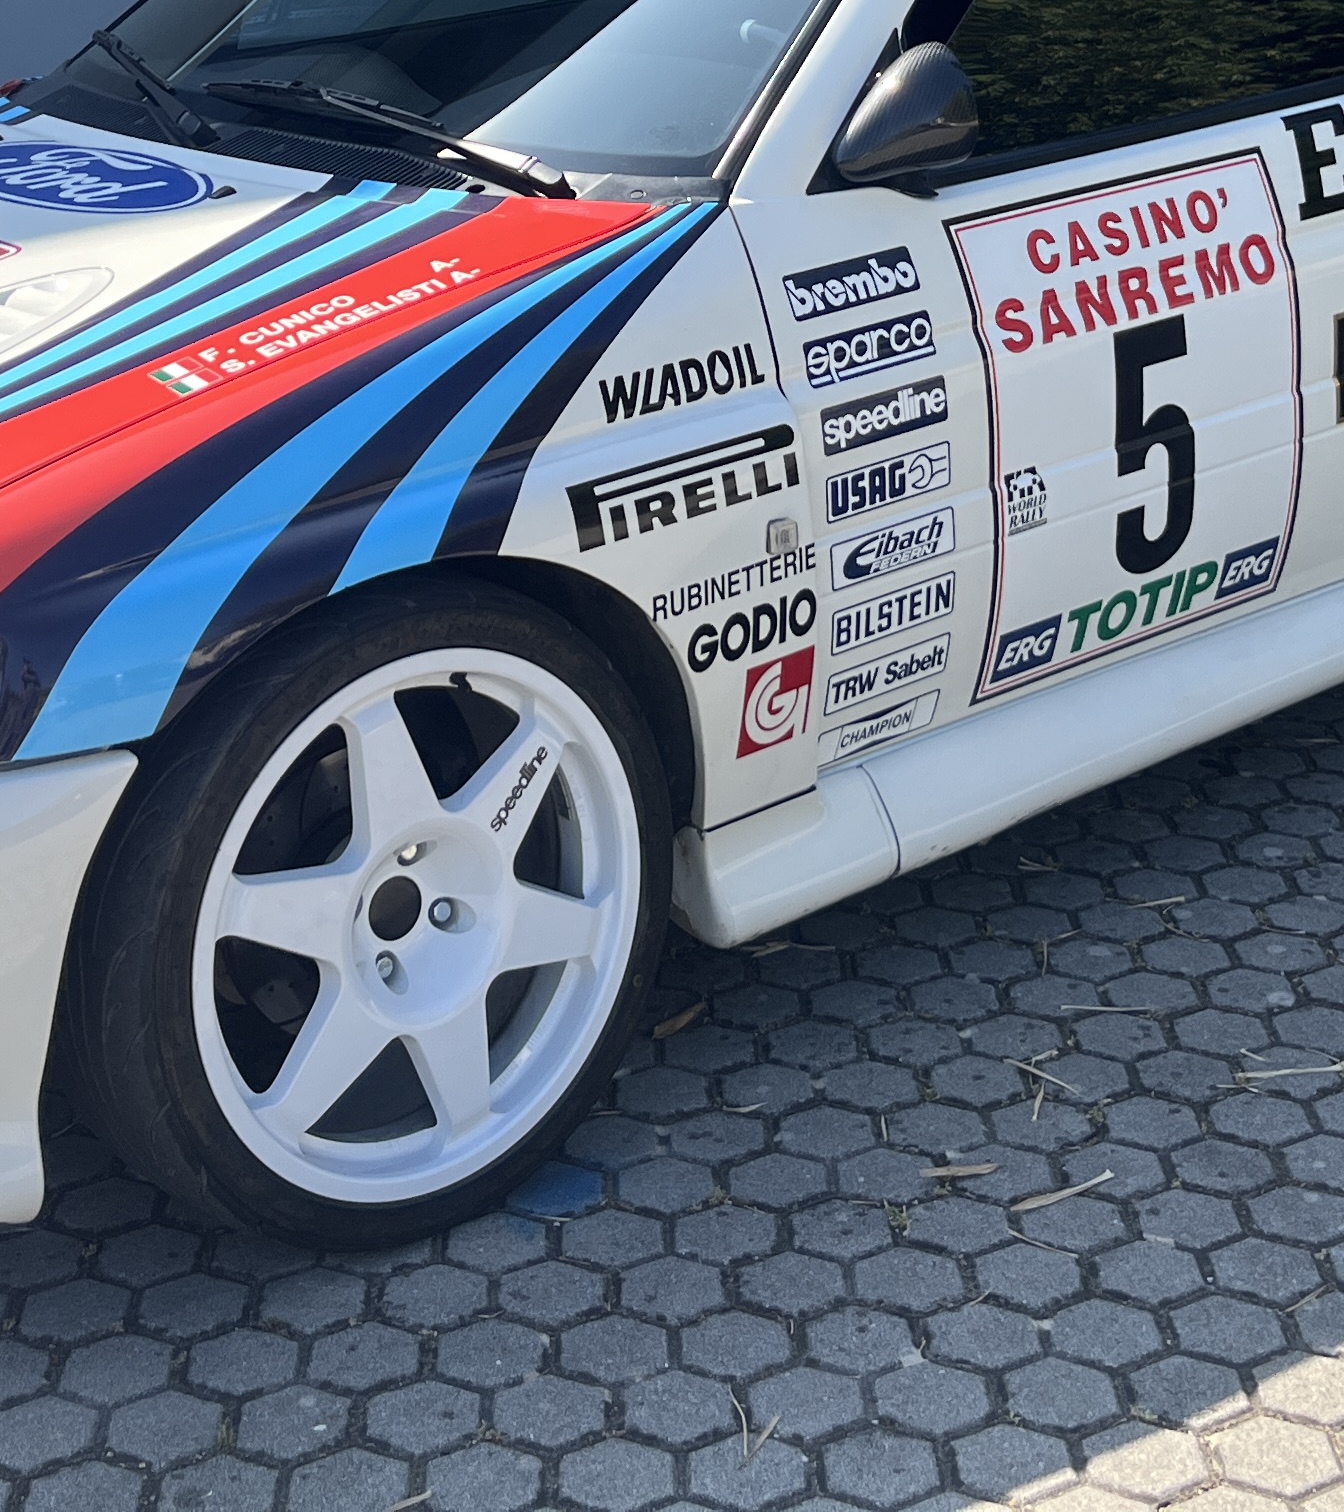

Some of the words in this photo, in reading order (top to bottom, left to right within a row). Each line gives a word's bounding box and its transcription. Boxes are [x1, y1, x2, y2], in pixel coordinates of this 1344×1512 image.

[1026, 187, 1229, 275] CASINO'
[789, 258, 917, 317] brembo
[994, 233, 1276, 354] SANREMO
[220, 359, 256, 374] S.
[256, 278, 446, 359] EVANGELISTI
[238, 295, 356, 346] CUNICO
[807, 317, 935, 383] sparco
[824, 385, 946, 450] speedline
[1113, 314, 1196, 574] 5
[565, 424, 801, 553] PIRELLI
[830, 462, 906, 517] USAG
[843, 517, 944, 580] Eibach
[1221, 546, 1273, 590] ERG
[652, 541, 816, 623] RUBINETTERIE
[1067, 559, 1218, 653] TOTIP
[687, 588, 816, 673] GODIO
[836, 584, 952, 648] BILSTEIN
[832, 675, 877, 706] TRW
[884, 646, 945, 684] Sabelt
[997, 625, 1057, 673] ERG
[839, 710, 912, 748] CHAMPION
[490, 744, 549, 832] speedline
